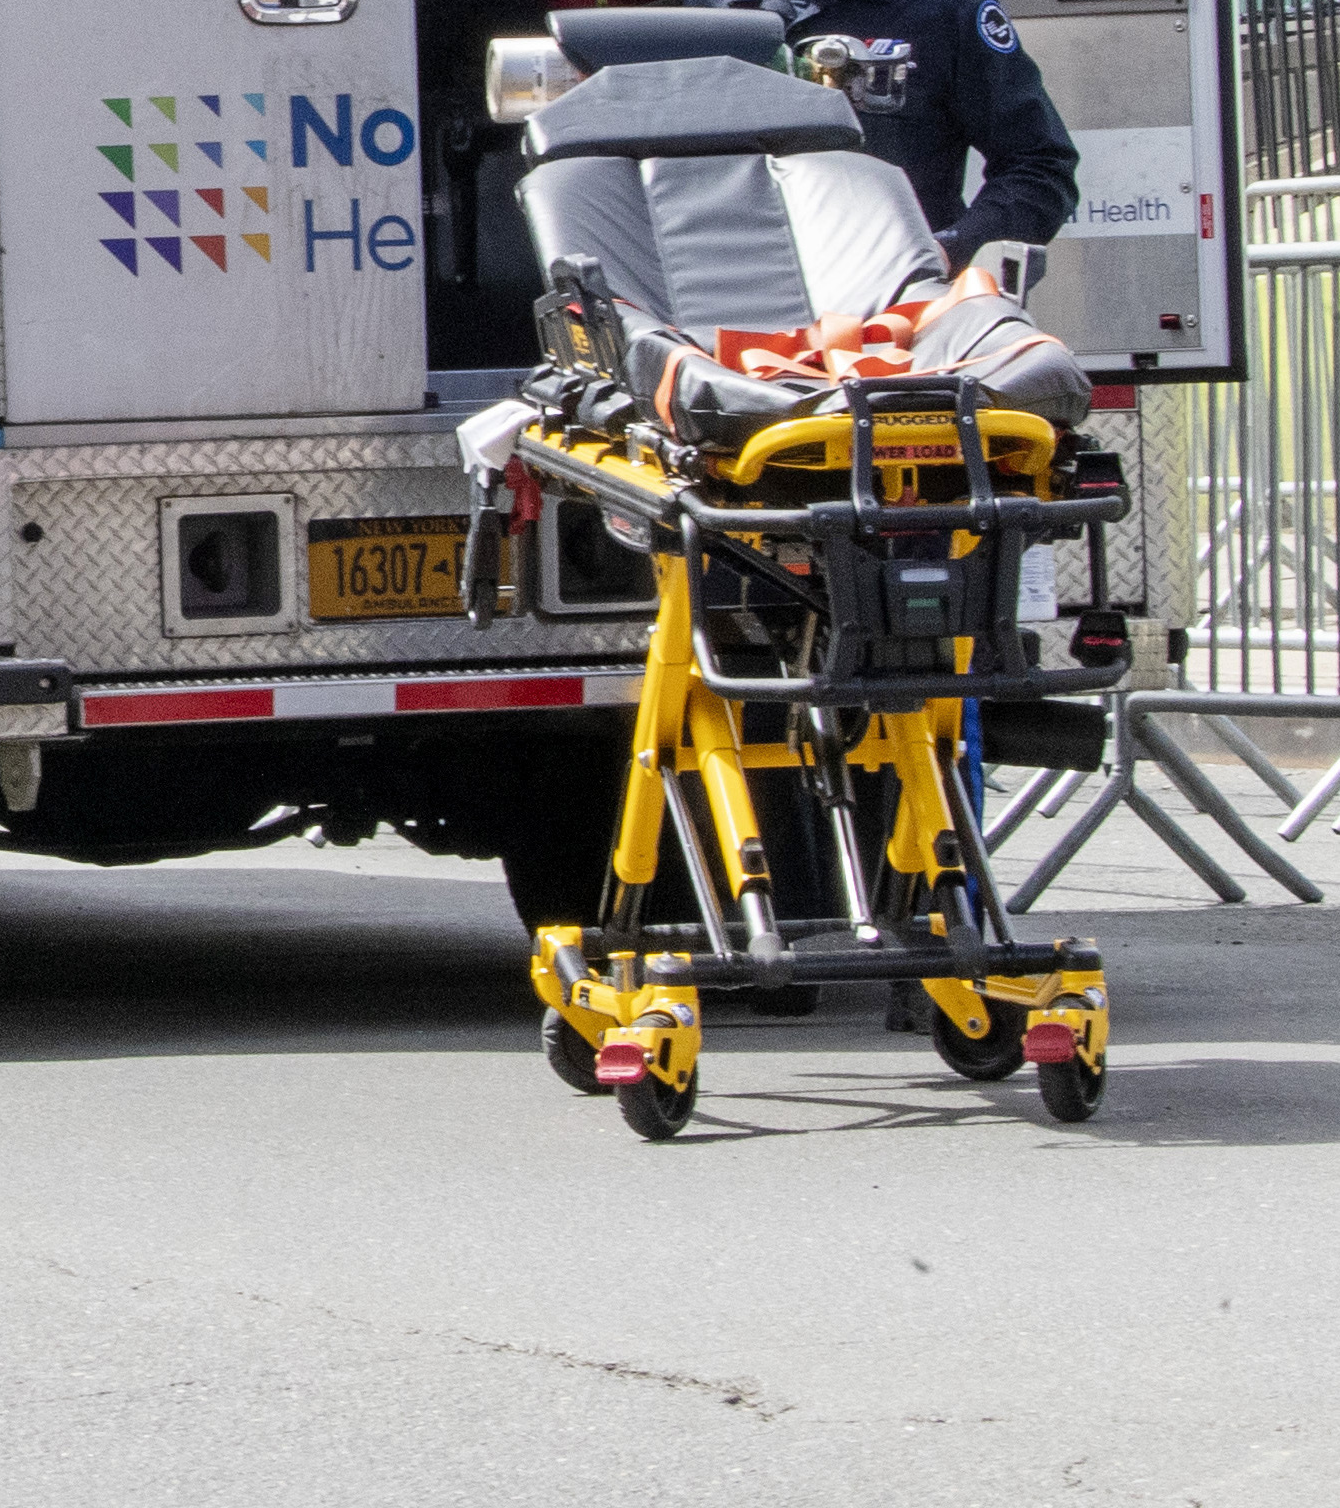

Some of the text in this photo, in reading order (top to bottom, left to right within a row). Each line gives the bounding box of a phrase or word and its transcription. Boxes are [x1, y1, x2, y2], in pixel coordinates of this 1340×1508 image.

[290, 93, 415, 168] No
[1088, 196, 1171, 223] Health
[304, 198, 416, 273] He
[913, 445, 957, 458] LOAD
[359, 519, 461, 536] NEW YORK
[333, 543, 428, 597] 16307
